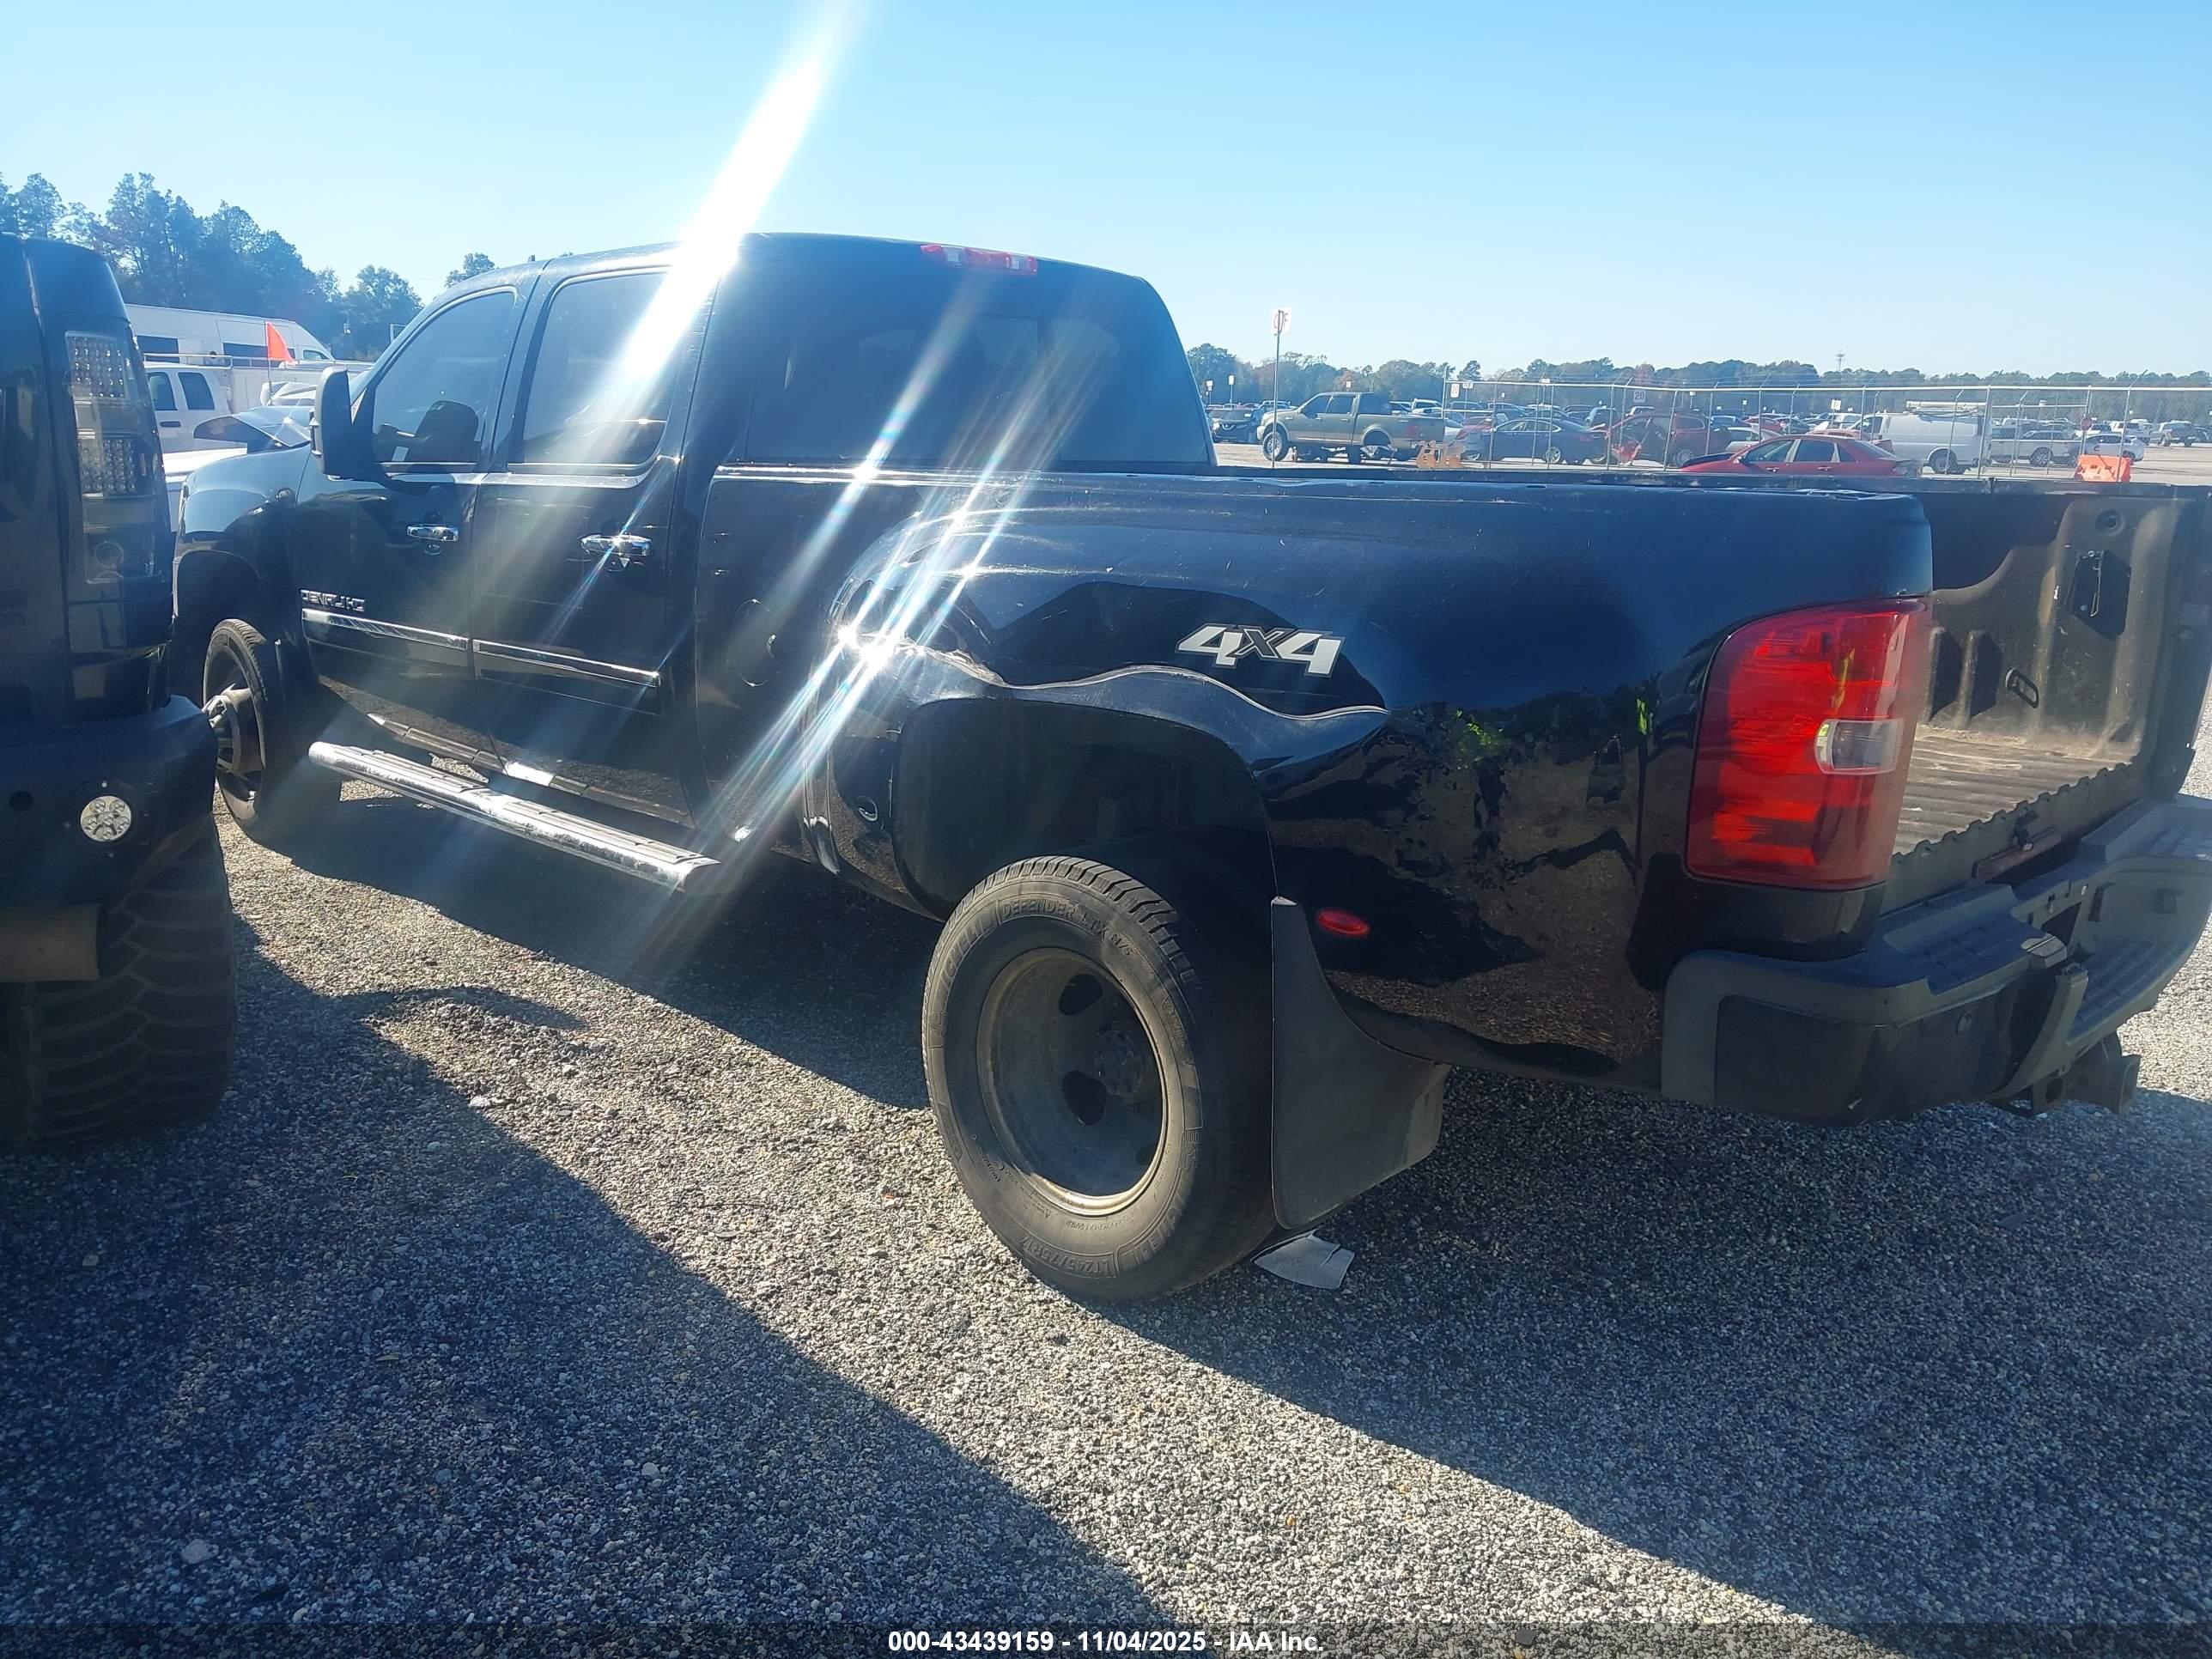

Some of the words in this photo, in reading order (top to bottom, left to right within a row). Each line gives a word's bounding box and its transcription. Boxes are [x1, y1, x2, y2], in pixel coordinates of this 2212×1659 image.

[1634, 391, 1644, 400] 20
[301, 589, 345, 609] DENALI
[345, 597, 365, 612] HD
[1001, 899, 1074, 920] DEFENDER
[1080, 912, 1109, 942] LTX
